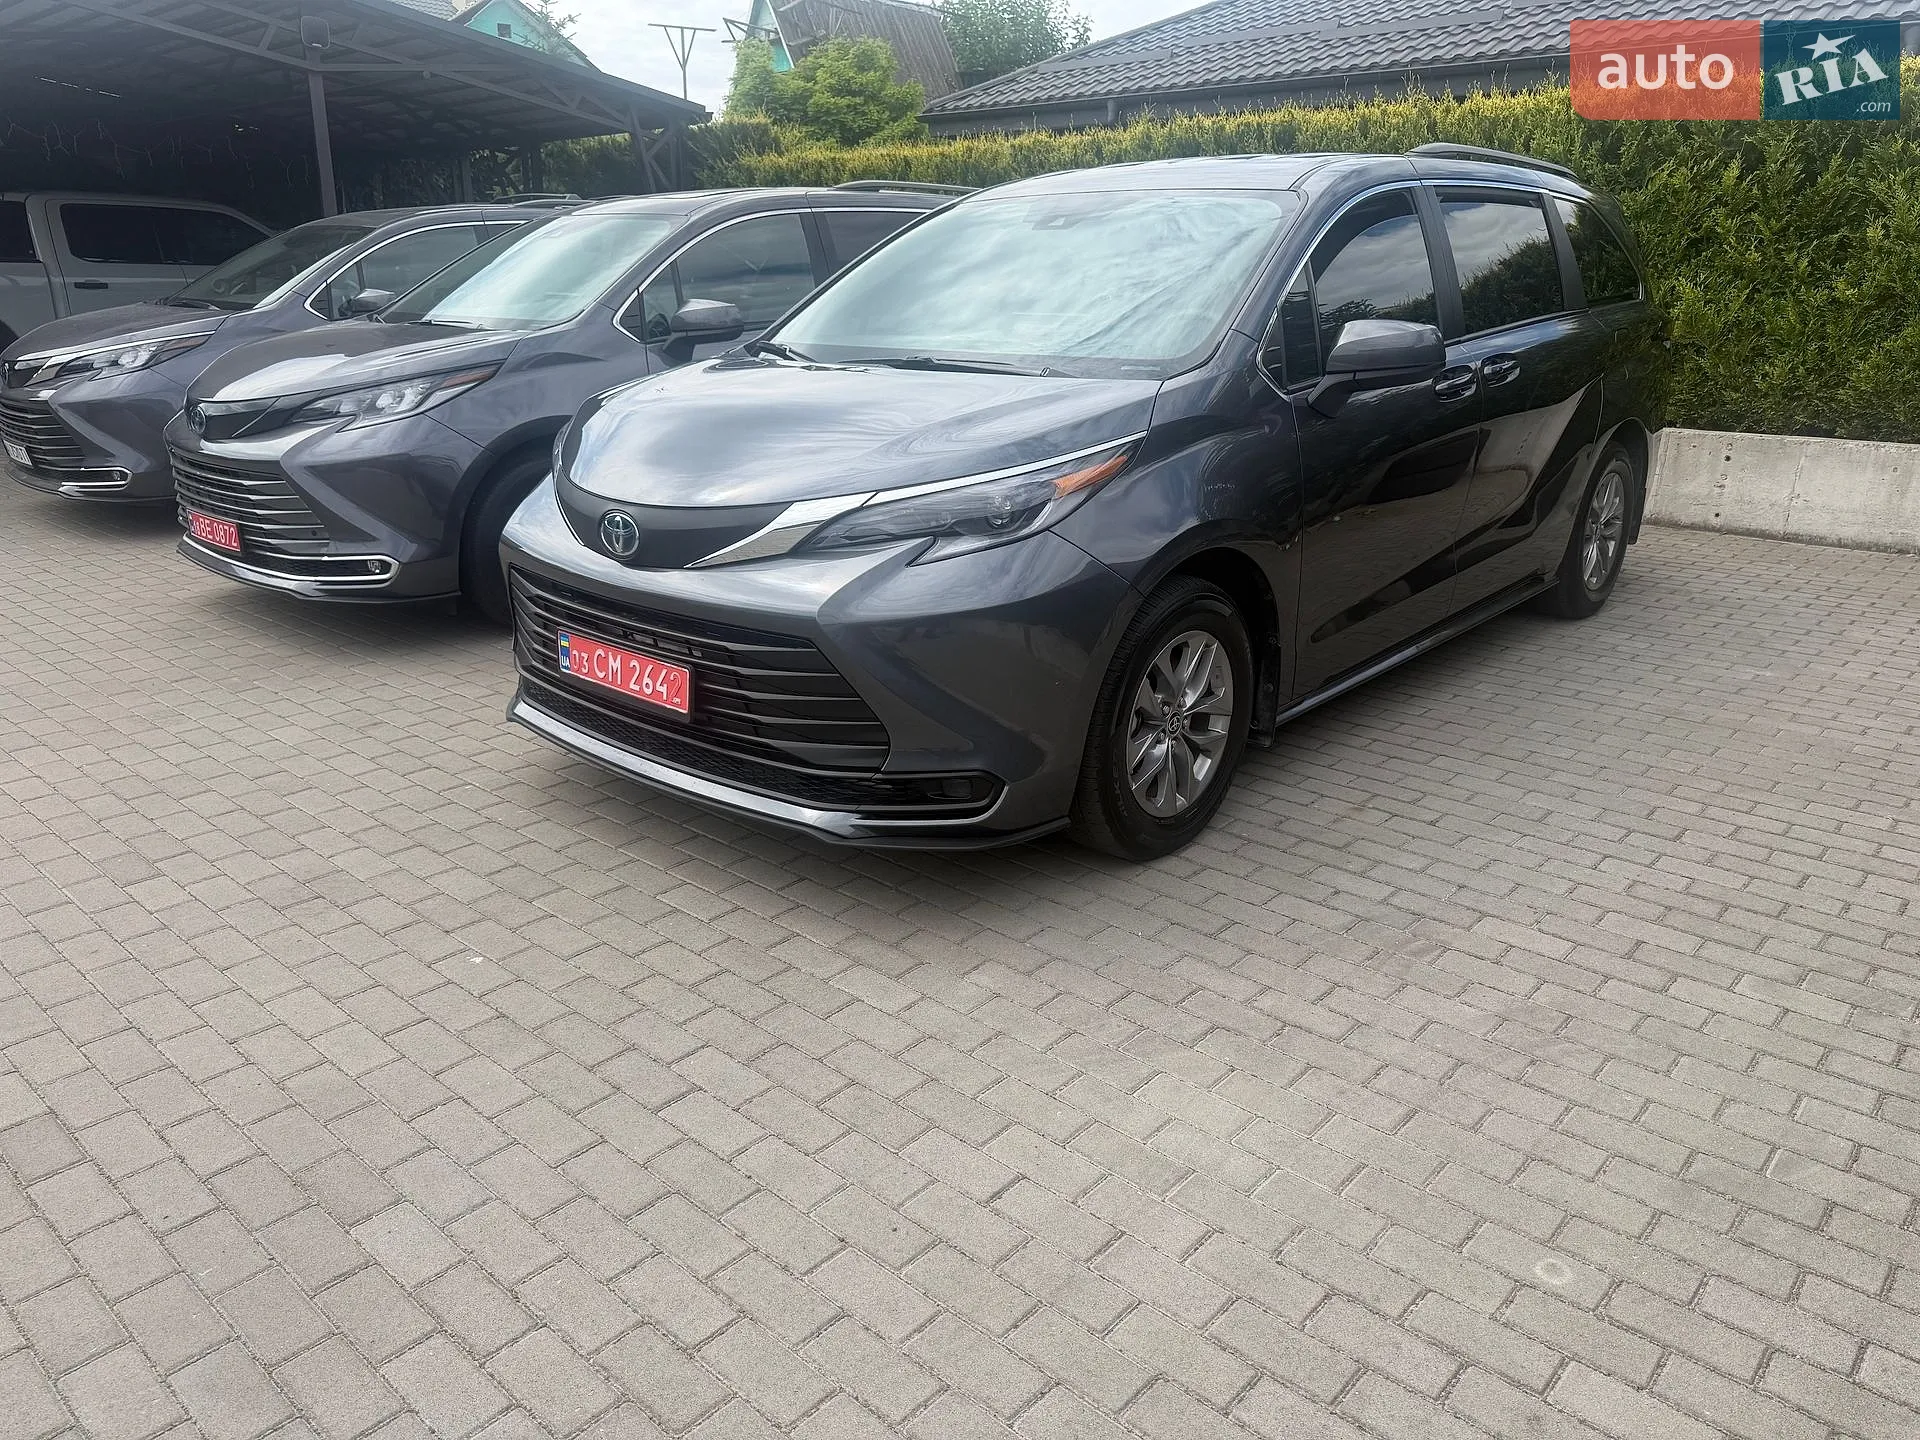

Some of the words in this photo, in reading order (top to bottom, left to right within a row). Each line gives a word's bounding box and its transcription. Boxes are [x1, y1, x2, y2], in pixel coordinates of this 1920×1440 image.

[199, 517, 213, 539] BE
[213, 522, 237, 547] 0872
[561, 656, 571, 668] UA
[593, 649, 622, 685] CM
[629, 659, 682, 705] 2642
